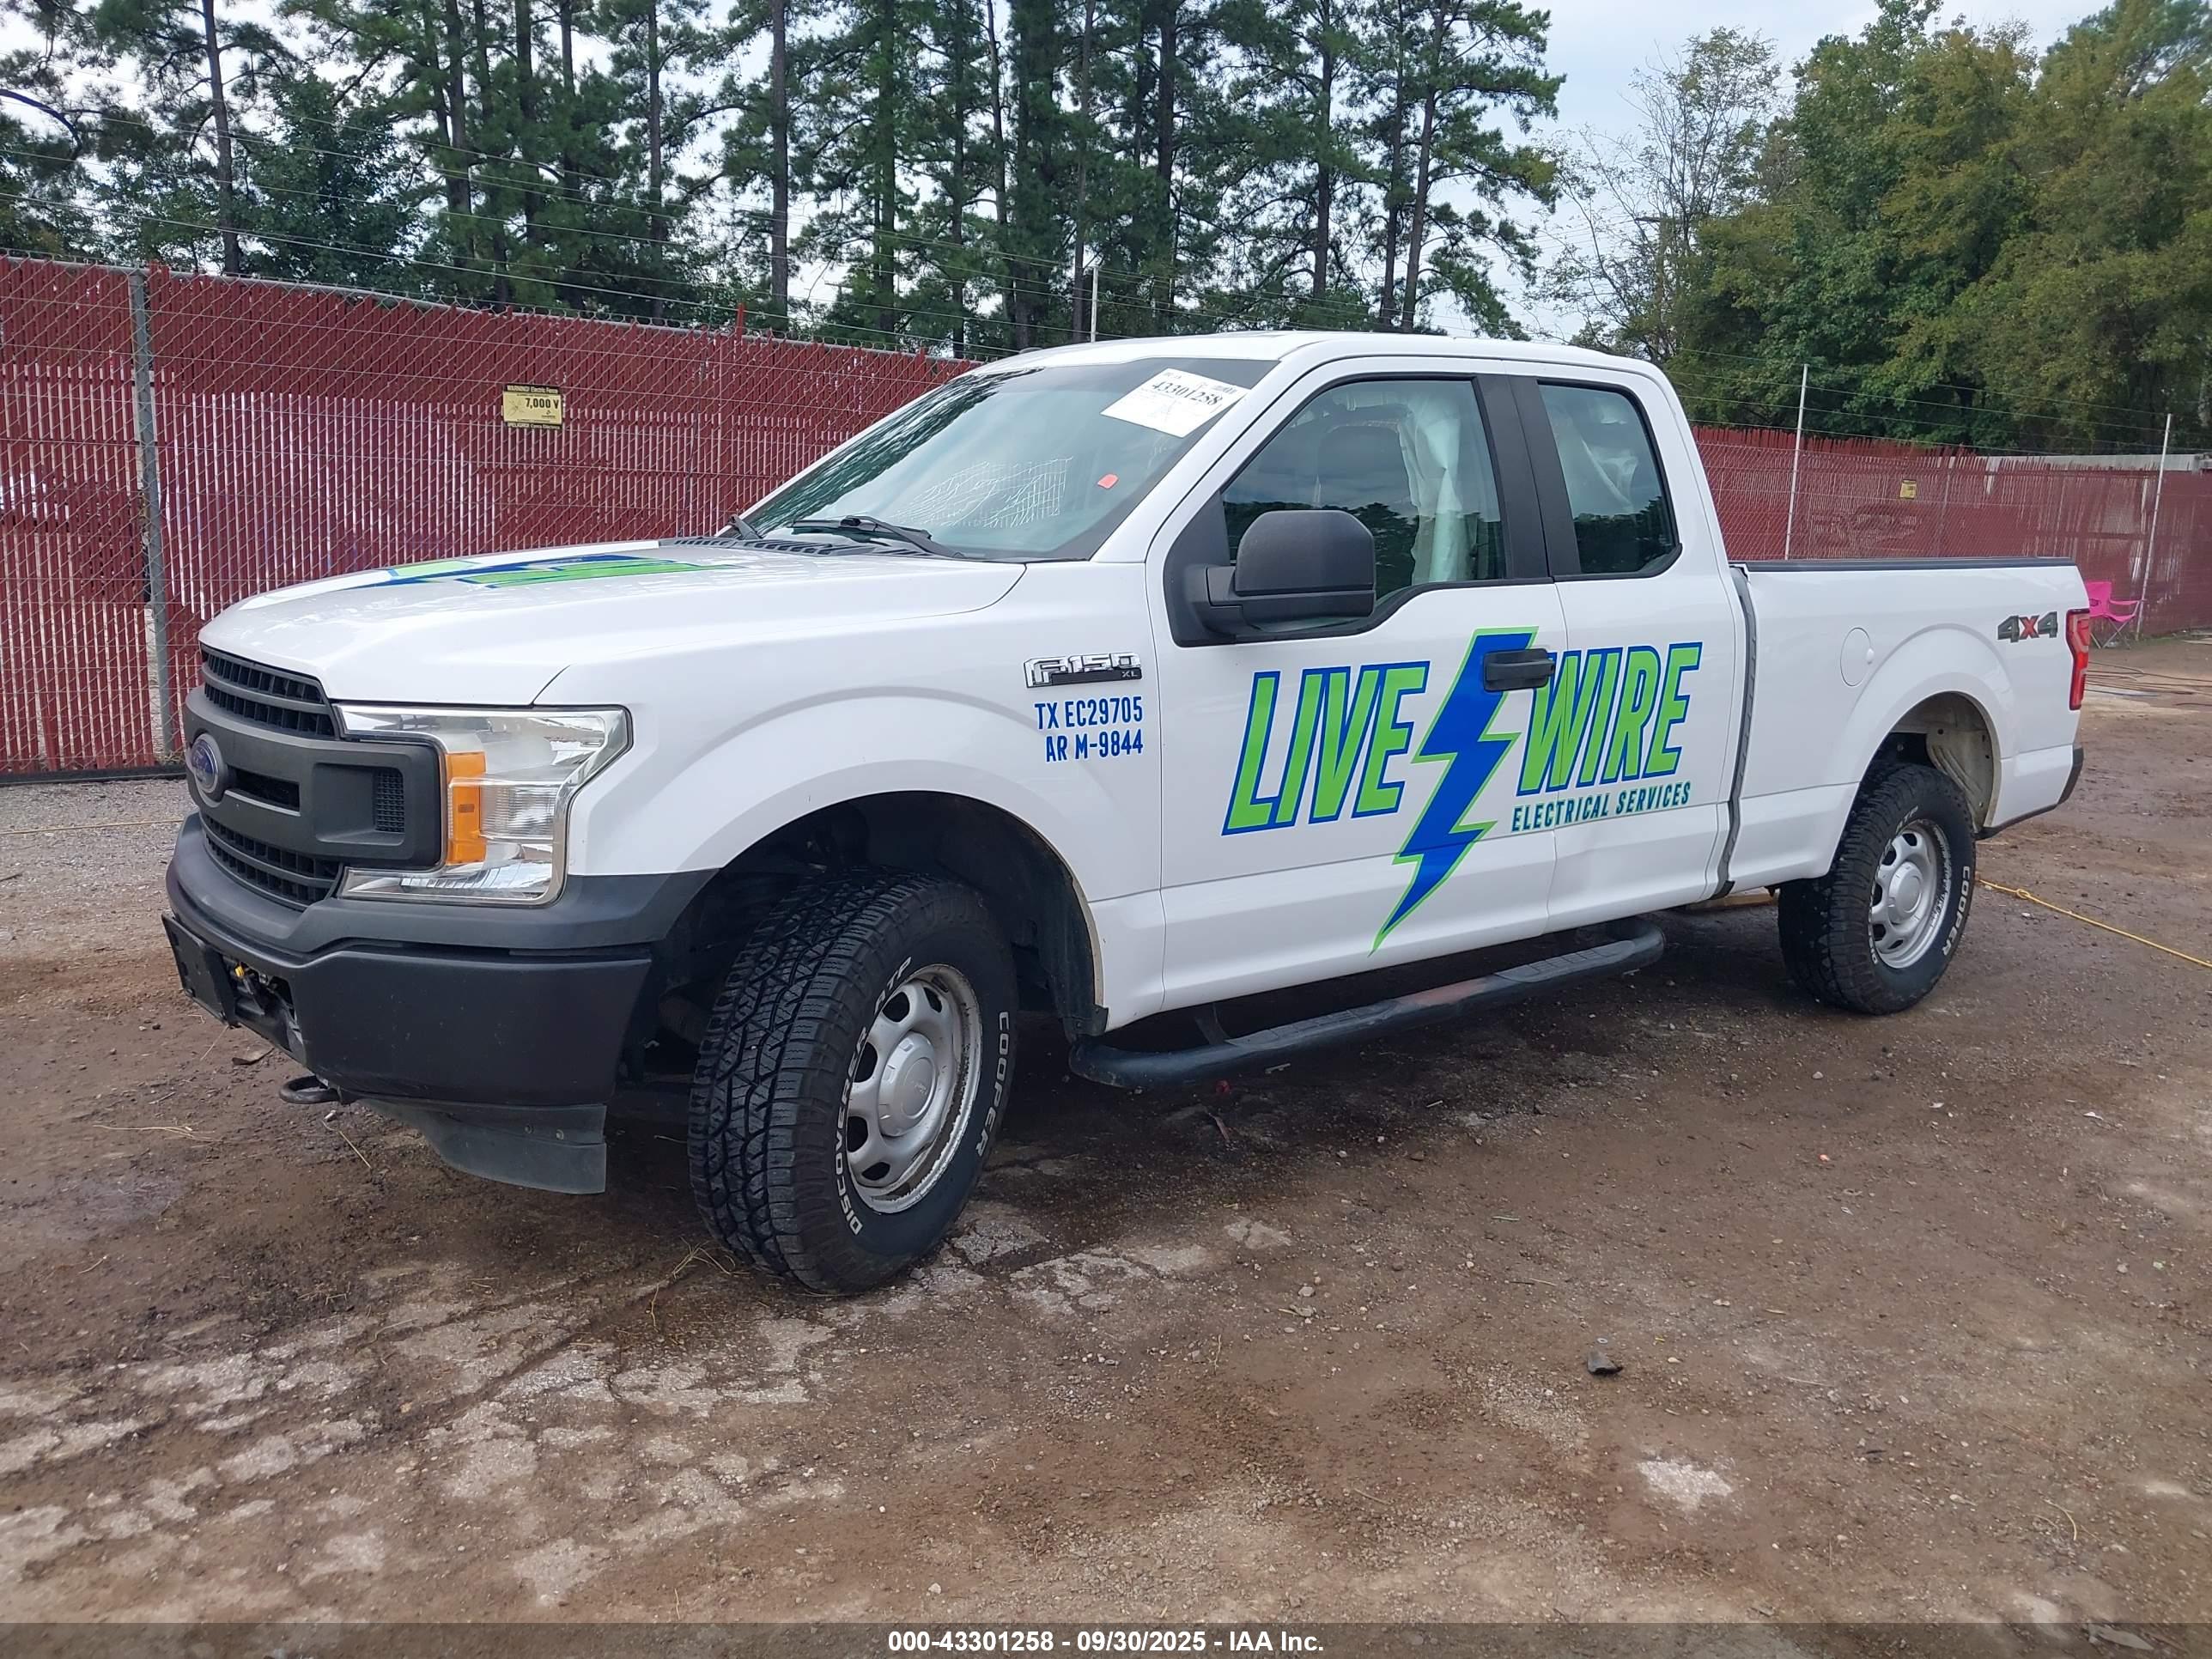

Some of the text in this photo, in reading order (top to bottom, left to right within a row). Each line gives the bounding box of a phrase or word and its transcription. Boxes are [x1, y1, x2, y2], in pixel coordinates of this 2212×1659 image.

[525, 398, 560, 410] 7,000 V
[1034, 696, 1143, 730] TX EC29705
[1046, 728, 1144, 763] AR M-9844
[1221, 641, 1704, 836] LIVE WIRE
[1511, 781, 1692, 833] ELECTRICAL SERVICES
[1942, 866, 1971, 957] COOPER
[975, 1011, 1011, 1158] COOPER
[836, 1026, 867, 1237] DISCOVERER
